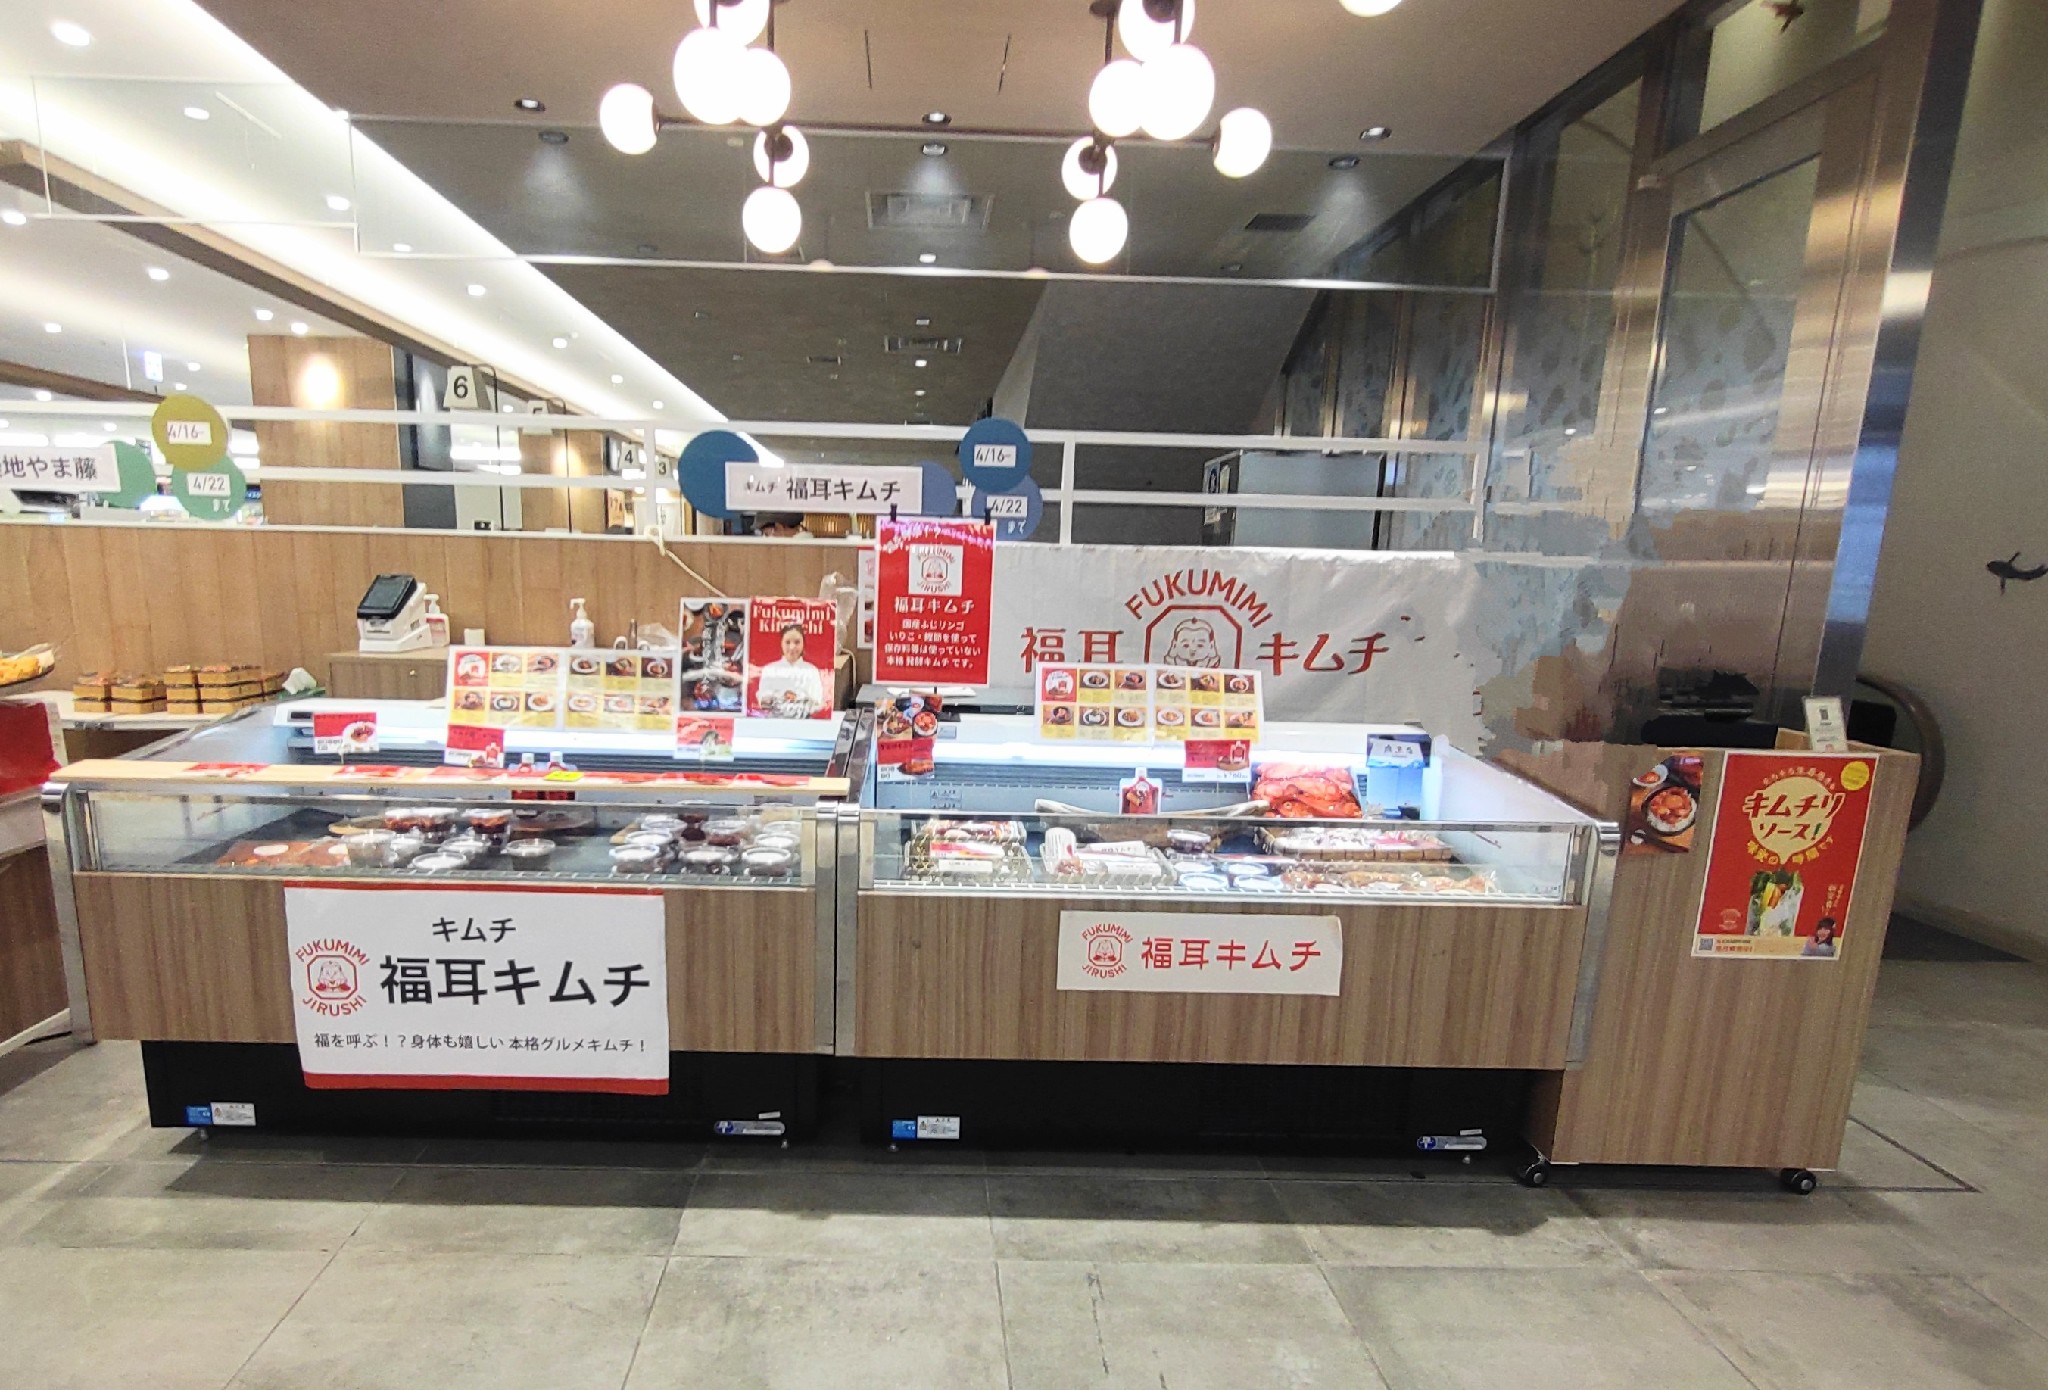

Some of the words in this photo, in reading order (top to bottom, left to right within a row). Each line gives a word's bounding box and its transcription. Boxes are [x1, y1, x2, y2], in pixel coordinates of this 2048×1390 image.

[452, 374, 469, 399] 6
[0, 454, 98, 481] 地やま藤
[623, 449, 634, 464] 4
[658, 461, 667, 476] 3
[192, 475, 226, 491] 4/22
[786, 477, 902, 501] 福耳キムチ
[989, 498, 1023, 514] 4/22
[894, 596, 975, 615] 福耳キムチ
[1124, 568, 1273, 628] FUKUMIMI
[753, 604, 831, 621] Fukumimi
[1020, 627, 1124, 673] 福耳
[1256, 630, 1391, 676] キムチ
[1744, 792, 1844, 819] キムチリ
[1759, 822, 1822, 841] ソース!
[432, 917, 517, 943] キムチ
[1081, 923, 1134, 944] FUKUMIMI
[295, 937, 371, 966] FUKUMIMI
[1140, 936, 1321, 972] 福耳キムチ
[379, 955, 651, 1007] 福耳キムチ
[1081, 963, 1128, 979] JIRUSHI
[302, 994, 367, 1018] JIRUSHI
